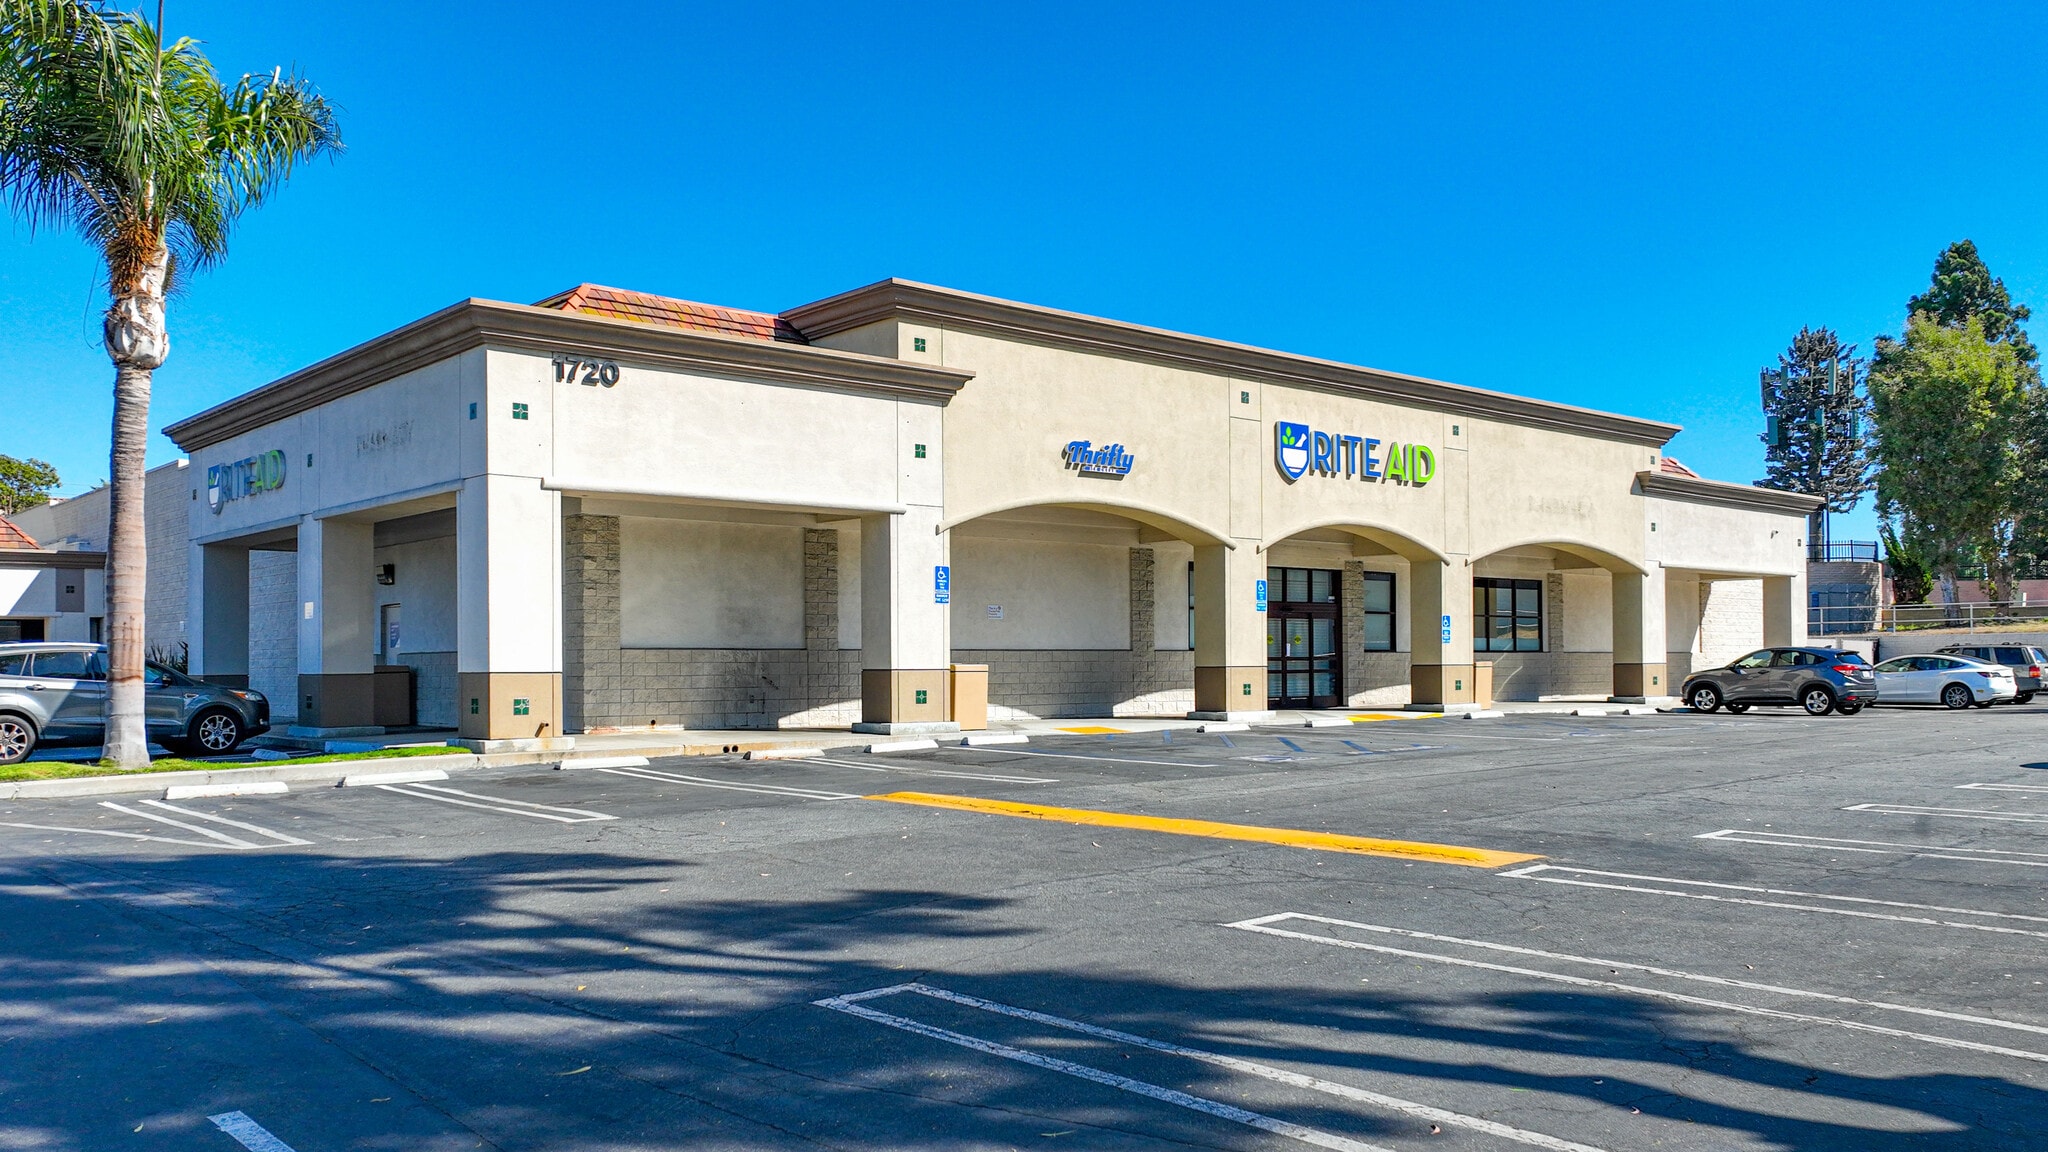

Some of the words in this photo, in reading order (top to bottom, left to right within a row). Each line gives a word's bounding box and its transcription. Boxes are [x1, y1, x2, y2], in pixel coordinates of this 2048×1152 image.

[553, 356, 620, 388] 1720
[221, 456, 257, 502] RITE
[255, 449, 286, 494] AID
[1065, 440, 1135, 475] Thrifty
[1311, 431, 1382, 478] RITE
[1384, 441, 1436, 483] AID
